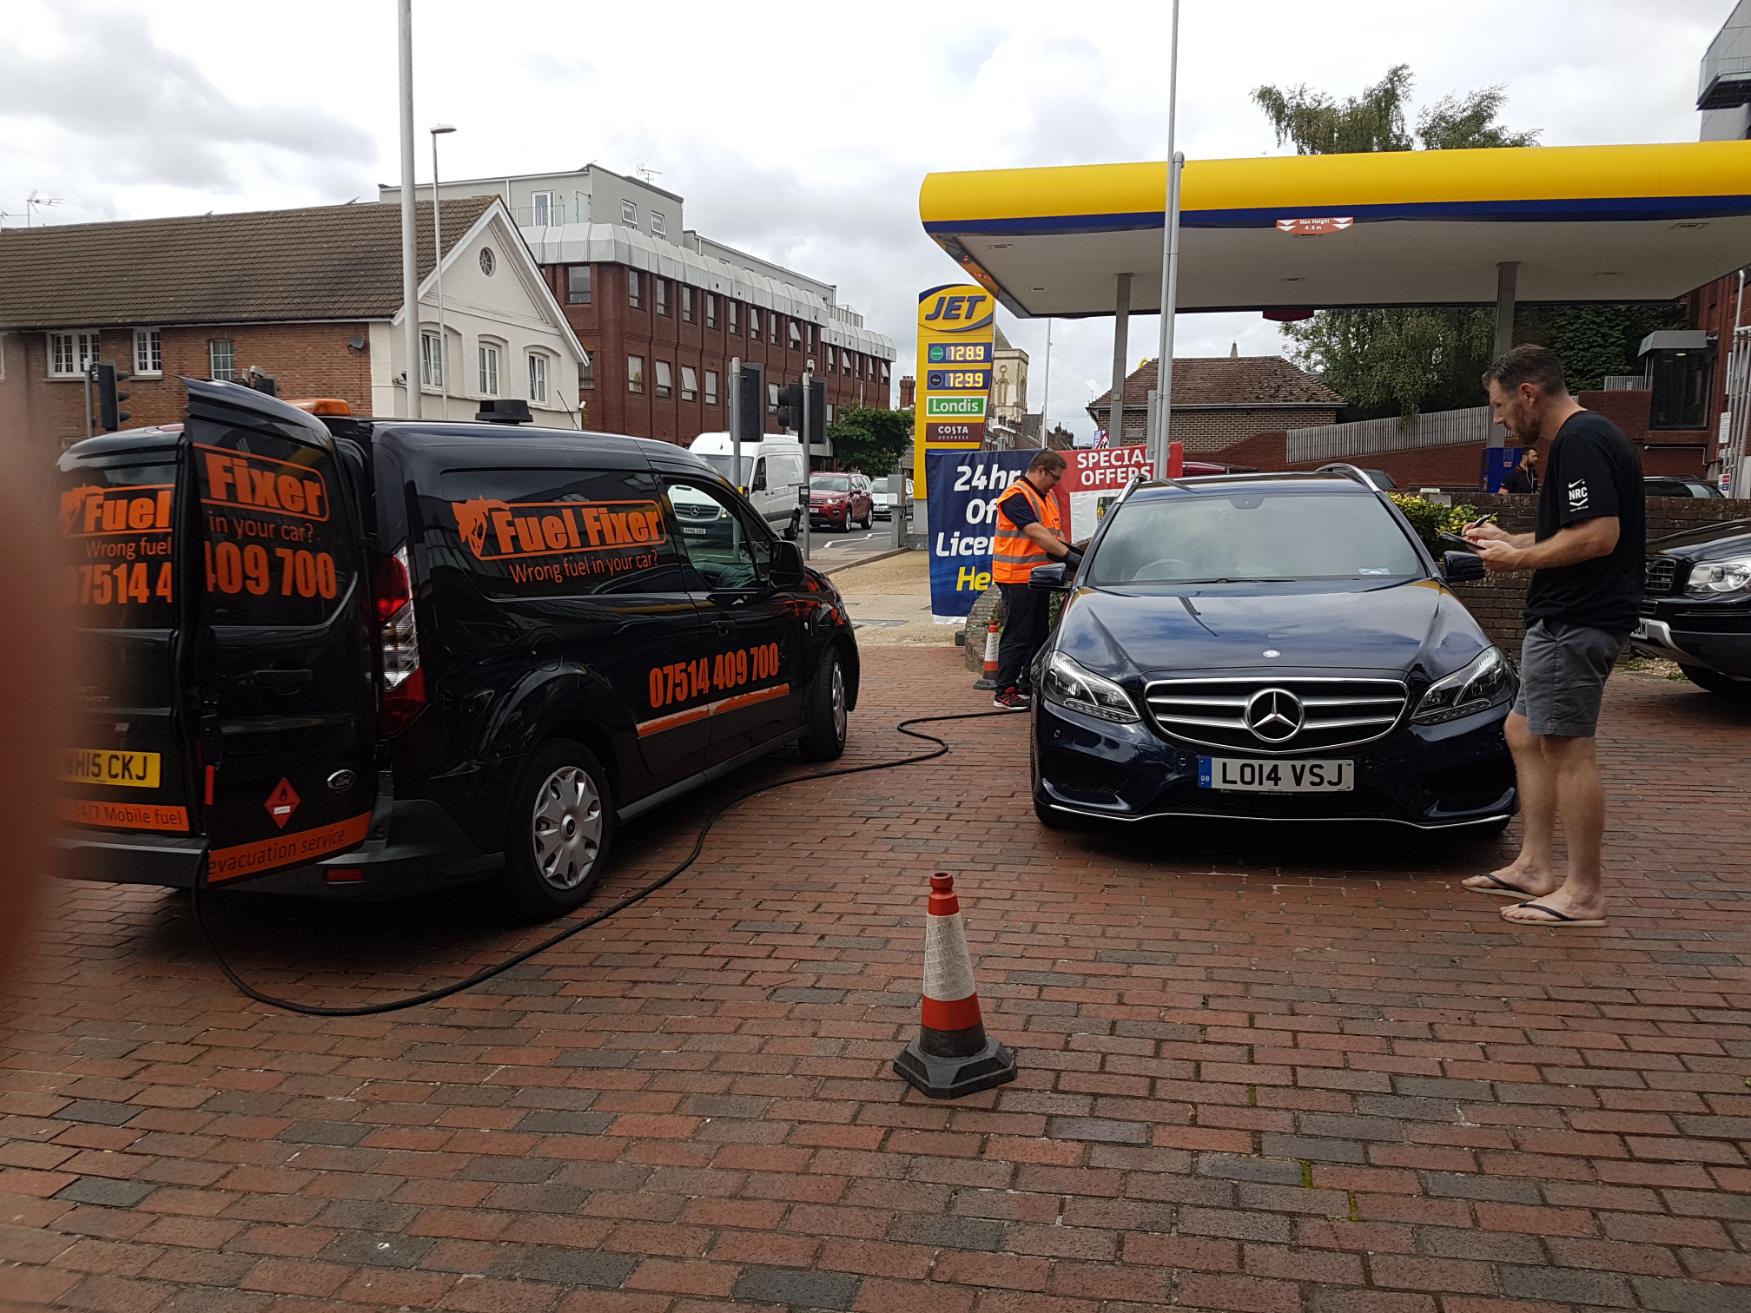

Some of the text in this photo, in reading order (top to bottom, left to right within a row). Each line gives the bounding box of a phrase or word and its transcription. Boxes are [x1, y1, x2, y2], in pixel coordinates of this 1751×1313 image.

[1311, 217, 1330, 225] Height
[925, 296, 987, 320] JET
[950, 346, 984, 360] 128.9
[949, 373, 983, 387] 129.9
[932, 399, 979, 412] Londis
[938, 426, 969, 434] COSTA
[1077, 449, 1154, 468] SPECIAL
[205, 453, 321, 516] Fixer
[954, 464, 1021, 491] 24hr
[1081, 466, 1151, 485] OFFERS
[1569, 487, 1588, 500] NRC
[84, 490, 171, 532] Fuel
[965, 498, 999, 525] Of
[208, 510, 313, 543] in your car?
[491, 507, 659, 554] Fuel Fixer
[86, 537, 172, 560] Wrong fuel
[275, 547, 337, 600] 700
[509, 550, 659, 584] Wrong fuel in your car?
[956, 566, 994, 592] He
[649, 642, 779, 709] 07514 409 700
[107, 754, 148, 781] CKJ
[1221, 761, 1343, 787] LO14 VSJ
[103, 806, 150, 823] Mobile
[154, 809, 182, 825] fuel
[208, 829, 346, 876] evacuation service
